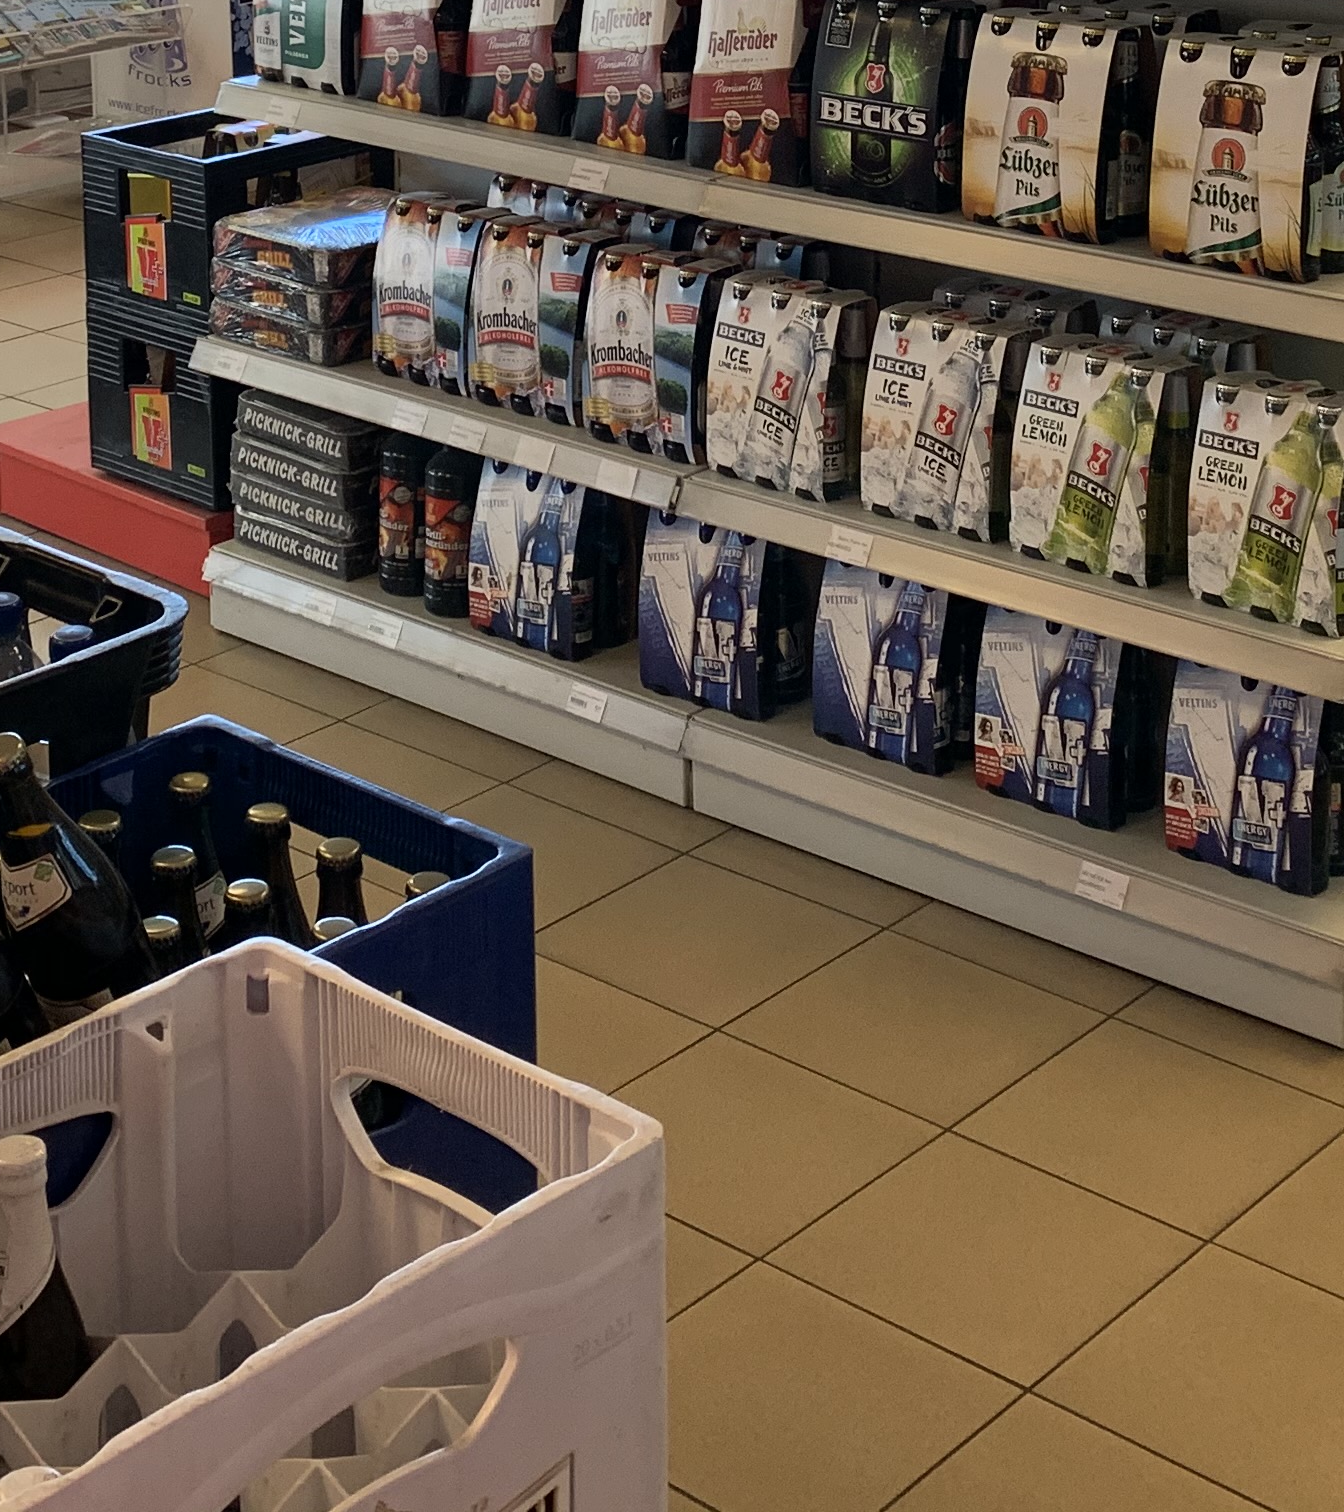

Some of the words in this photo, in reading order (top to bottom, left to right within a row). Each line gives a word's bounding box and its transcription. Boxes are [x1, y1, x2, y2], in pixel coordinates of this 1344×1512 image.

[820, 96, 927, 137] BECK'S
[998, 144, 1059, 179] Lübzer
[1014, 178, 1040, 198] Pils
[1190, 178, 1260, 213] Lübzer
[1208, 212, 1239, 234] Pils
[379, 284, 432, 305] Krombacher
[476, 311, 538, 333] Krombacher
[717, 324, 764, 345] BECK'S
[591, 343, 653, 369] Krombacher
[725, 345, 750, 365] ICE
[875, 356, 926, 378] BECK'S
[883, 378, 909, 399] ICE
[756, 398, 796, 429] BECK'S
[1024, 393, 1078, 416] BECK'S
[242, 406, 343, 459] PICKNICK-GRILL
[762, 419, 784, 438] ICE
[1029, 414, 1064, 432] GREEN
[916, 433, 961, 464] BECK'S
[1021, 426, 1068, 448] LEMON
[1200, 433, 1258, 457] BECK'S
[236, 446, 338, 499] PICKNICK-GRILL
[923, 454, 947, 477] ICE
[1205, 454, 1244, 474] GREEN
[1197, 467, 1248, 491] LEMON
[1068, 473, 1116, 509] BECK'S
[239, 481, 347, 533] PICKNICK-GRILL
[239, 518, 339, 572] PICKNICK-GRILL
[1249, 517, 1302, 551] BECK'S
